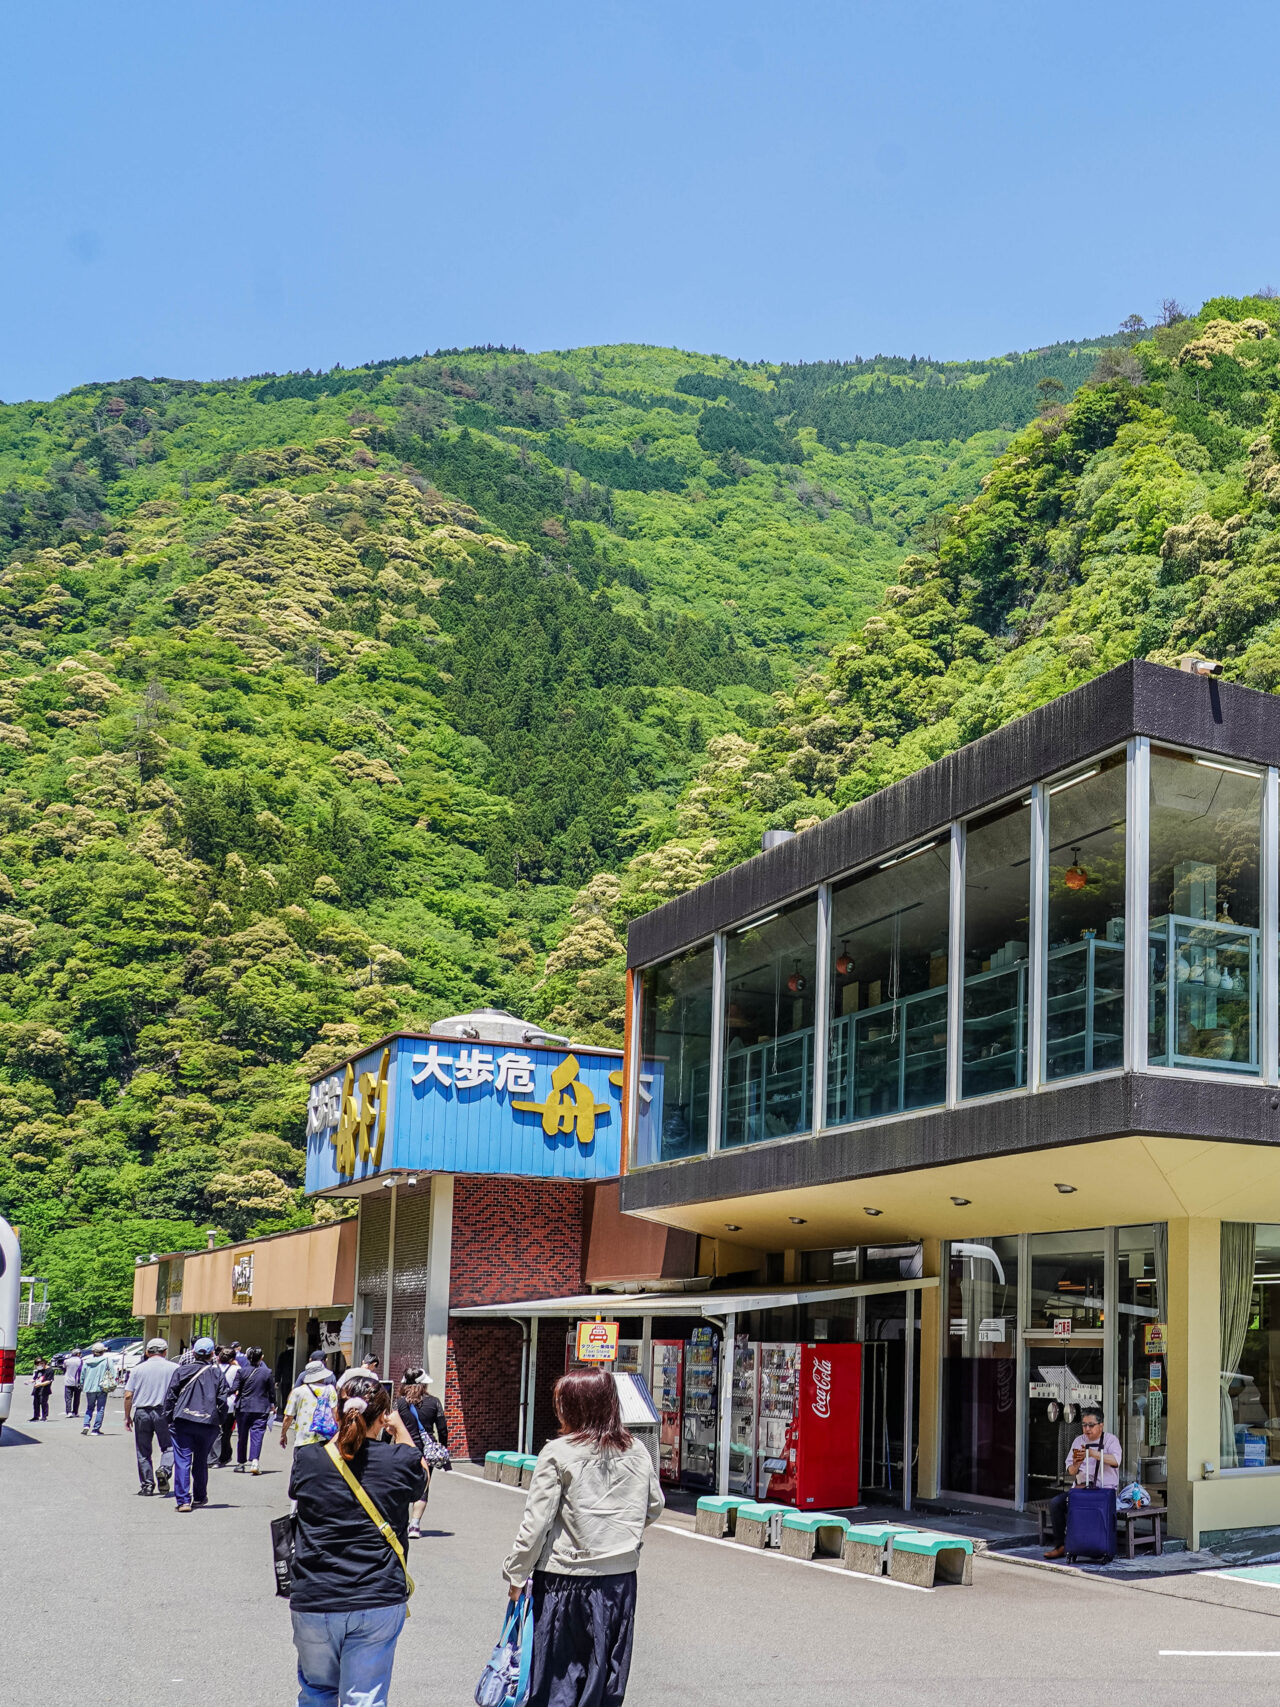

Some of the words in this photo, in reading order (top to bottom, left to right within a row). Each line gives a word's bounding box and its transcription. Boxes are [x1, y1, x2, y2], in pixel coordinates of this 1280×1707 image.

[411, 1045, 535, 1093] 大歩危
[511, 1053, 624, 1144] 舟
[811, 1356, 832, 1419] Coca-Cola
